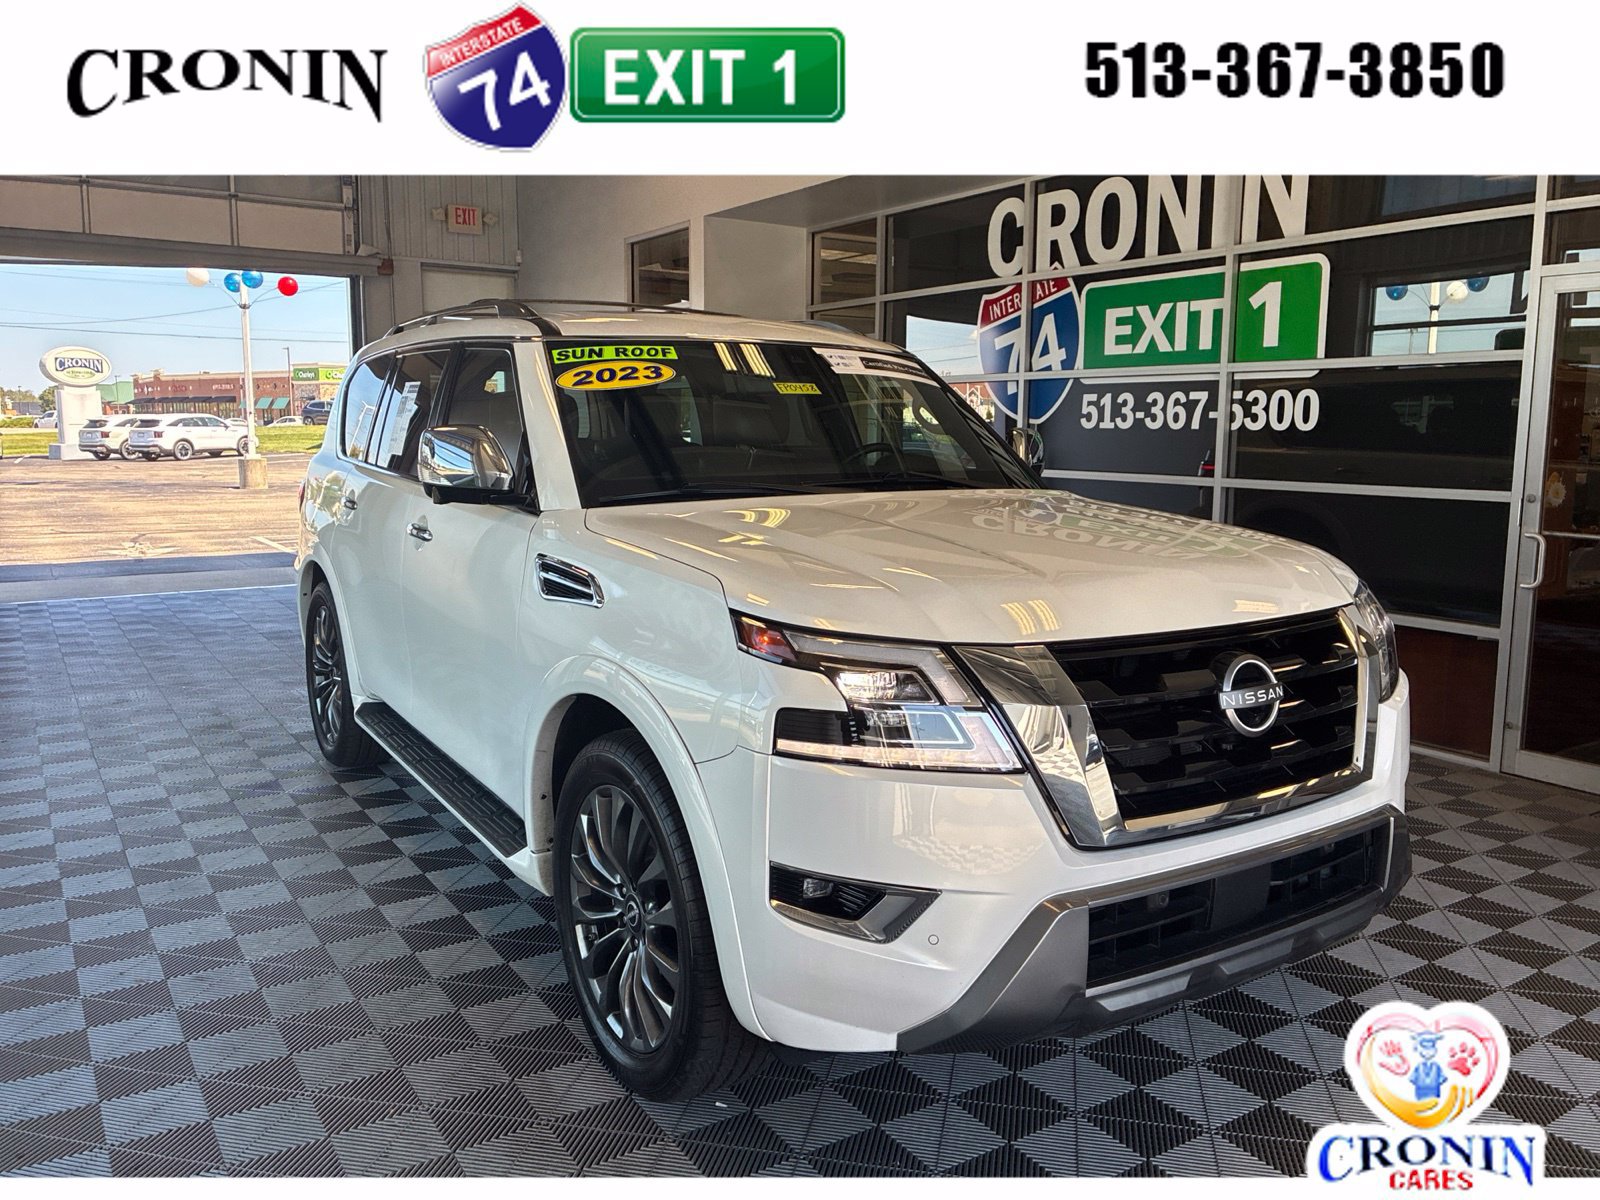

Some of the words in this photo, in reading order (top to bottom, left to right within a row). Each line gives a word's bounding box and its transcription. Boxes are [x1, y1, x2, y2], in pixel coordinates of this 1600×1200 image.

[455, 207, 477, 226] EXIT
[986, 172, 1309, 279] CRONIN
[988, 278, 1058, 321] INTERATE
[1103, 298, 1225, 356] EXIT
[1248, 280, 1282, 348] 1
[55, 357, 102, 373] CRONIN
[556, 347, 604, 361] SUN
[614, 347, 672, 358] ROOF
[994, 312, 1067, 396] 74
[571, 365, 663, 387] 2023
[1222, 686, 1284, 706] NISSAN
